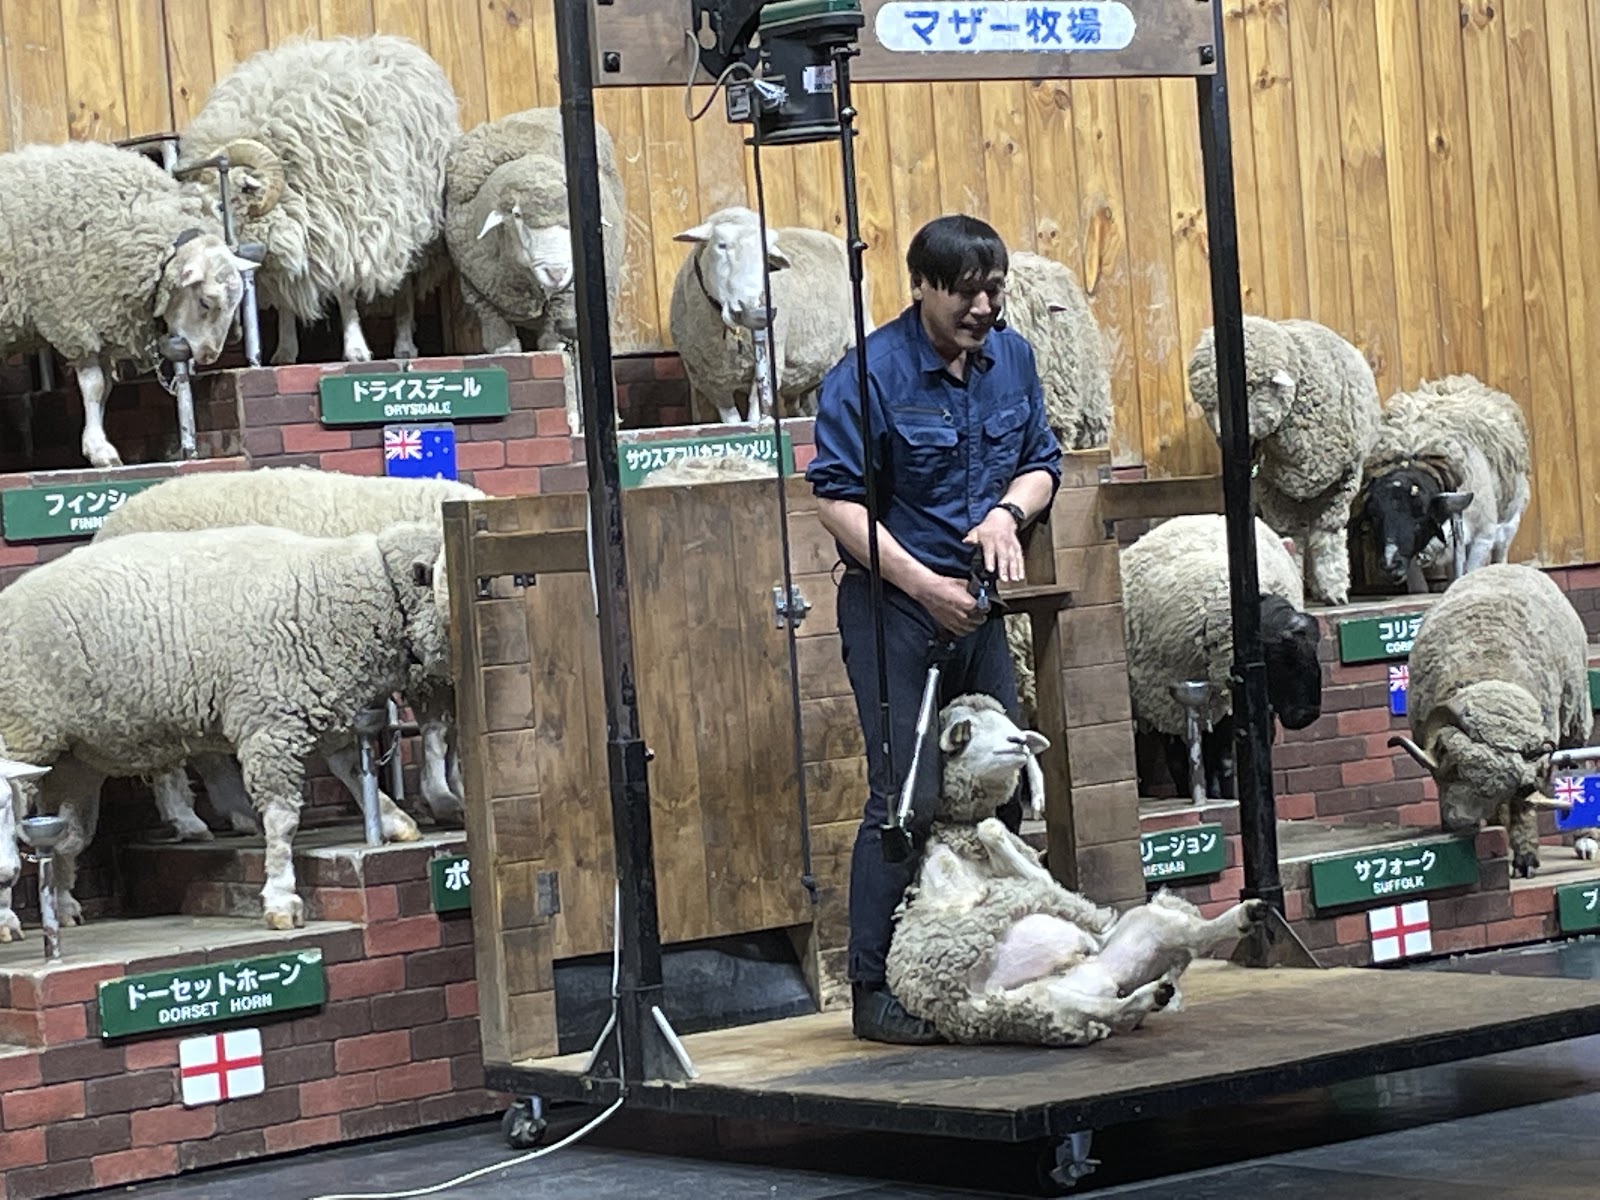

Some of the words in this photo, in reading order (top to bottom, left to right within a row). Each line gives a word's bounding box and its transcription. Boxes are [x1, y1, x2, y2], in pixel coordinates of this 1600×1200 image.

[904, 7, 1102, 45] マザー牧場
[353, 377, 481, 402] ドライスデール
[45, 489, 126, 515] フィンシ
[1140, 833, 1216, 862] リージョン
[1354, 850, 1436, 881] サフォーク
[1373, 875, 1424, 894] SUFFOLK
[128, 963, 300, 1010] ドーセットホーン
[159, 1000, 220, 1023] DORSET
[231, 993, 272, 1012] HORN
